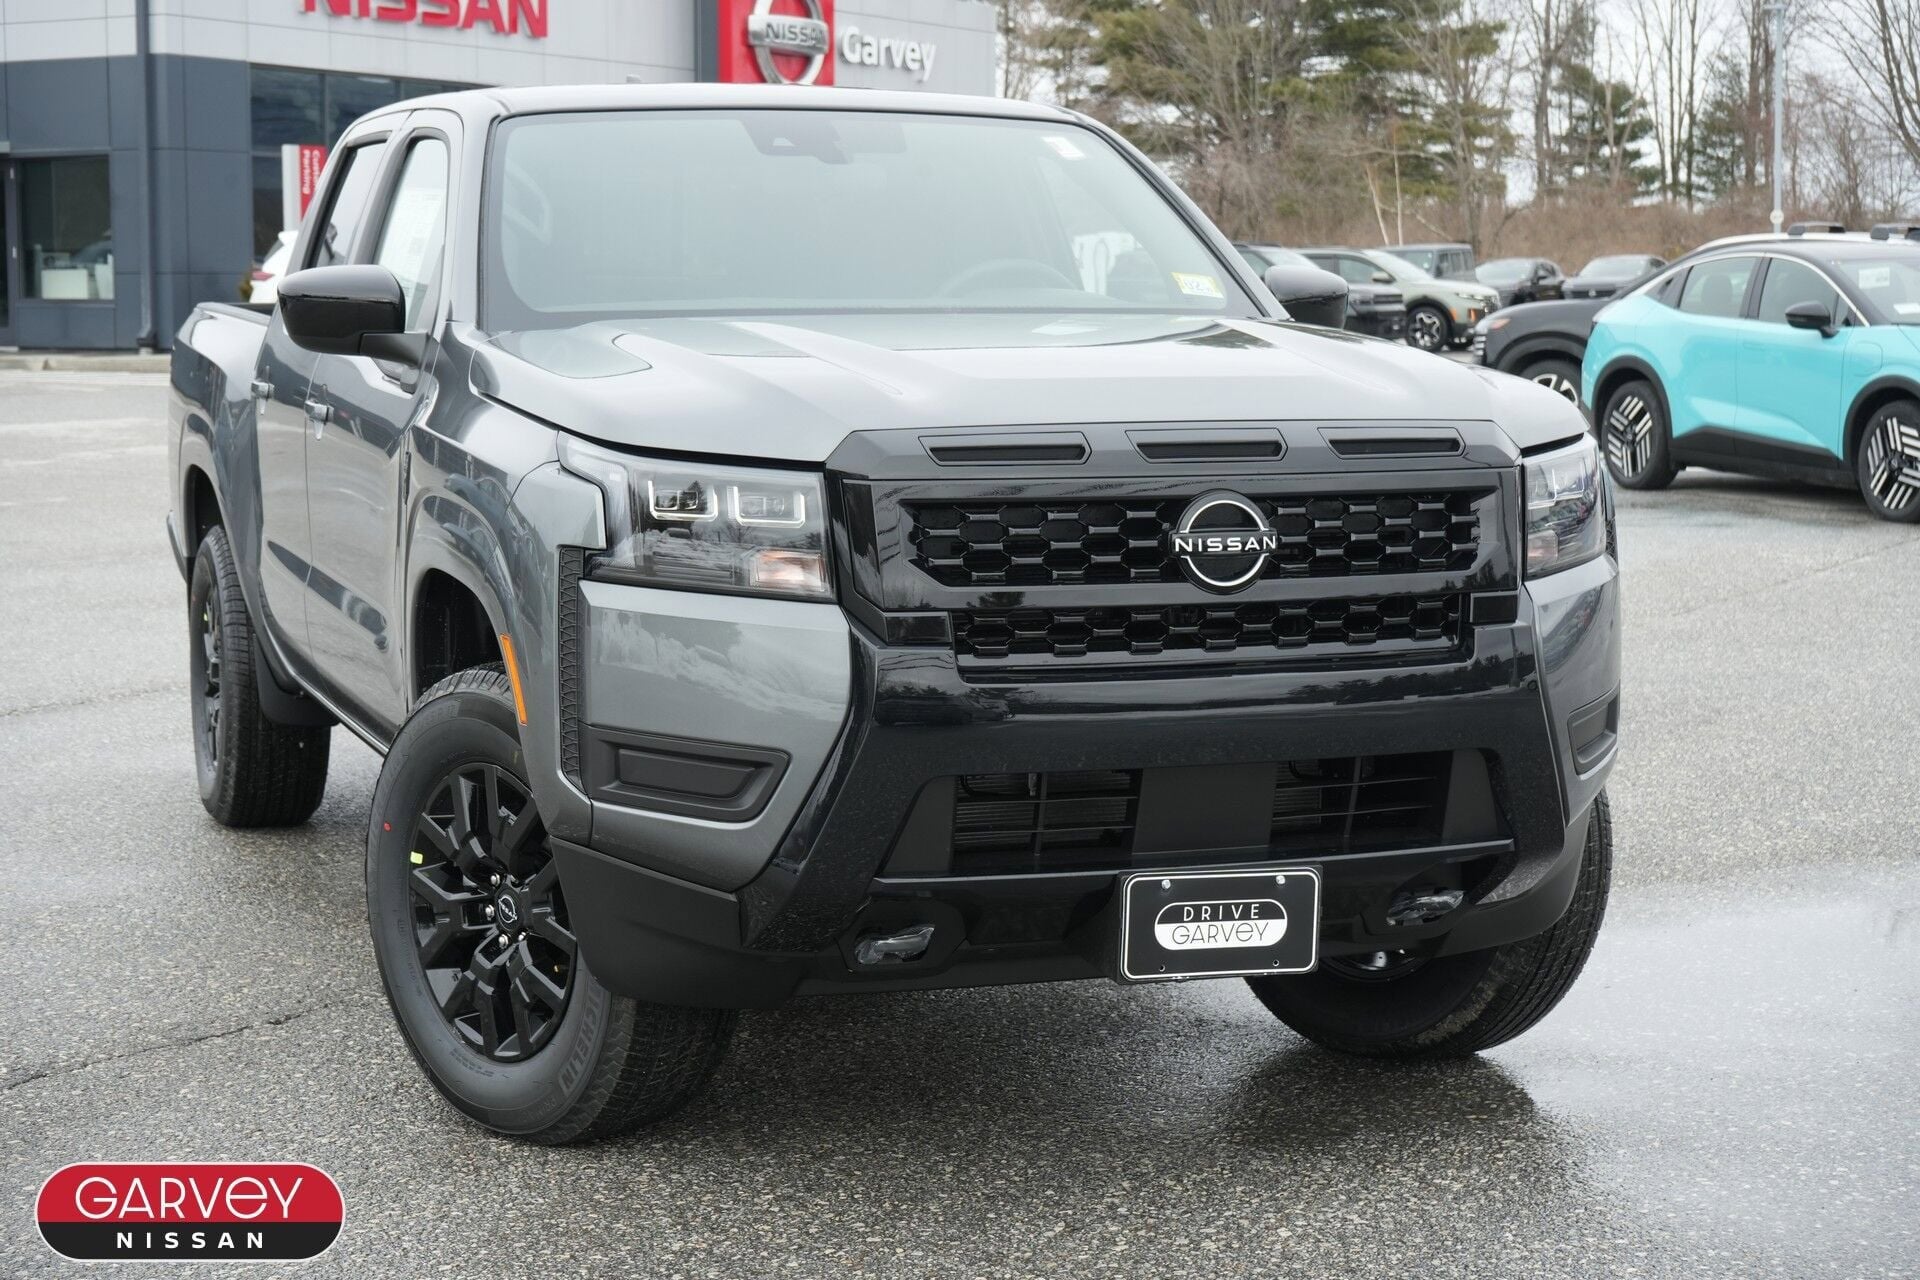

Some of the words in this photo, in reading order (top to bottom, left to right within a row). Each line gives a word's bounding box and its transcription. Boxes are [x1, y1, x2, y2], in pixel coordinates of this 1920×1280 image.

[303, 0, 547, 38] SAN
[842, 26, 936, 82] Garvey
[1175, 535, 1276, 552] NISSAN
[1183, 904, 1260, 921] DRIVE
[561, 978, 602, 1090] ICHELIN
